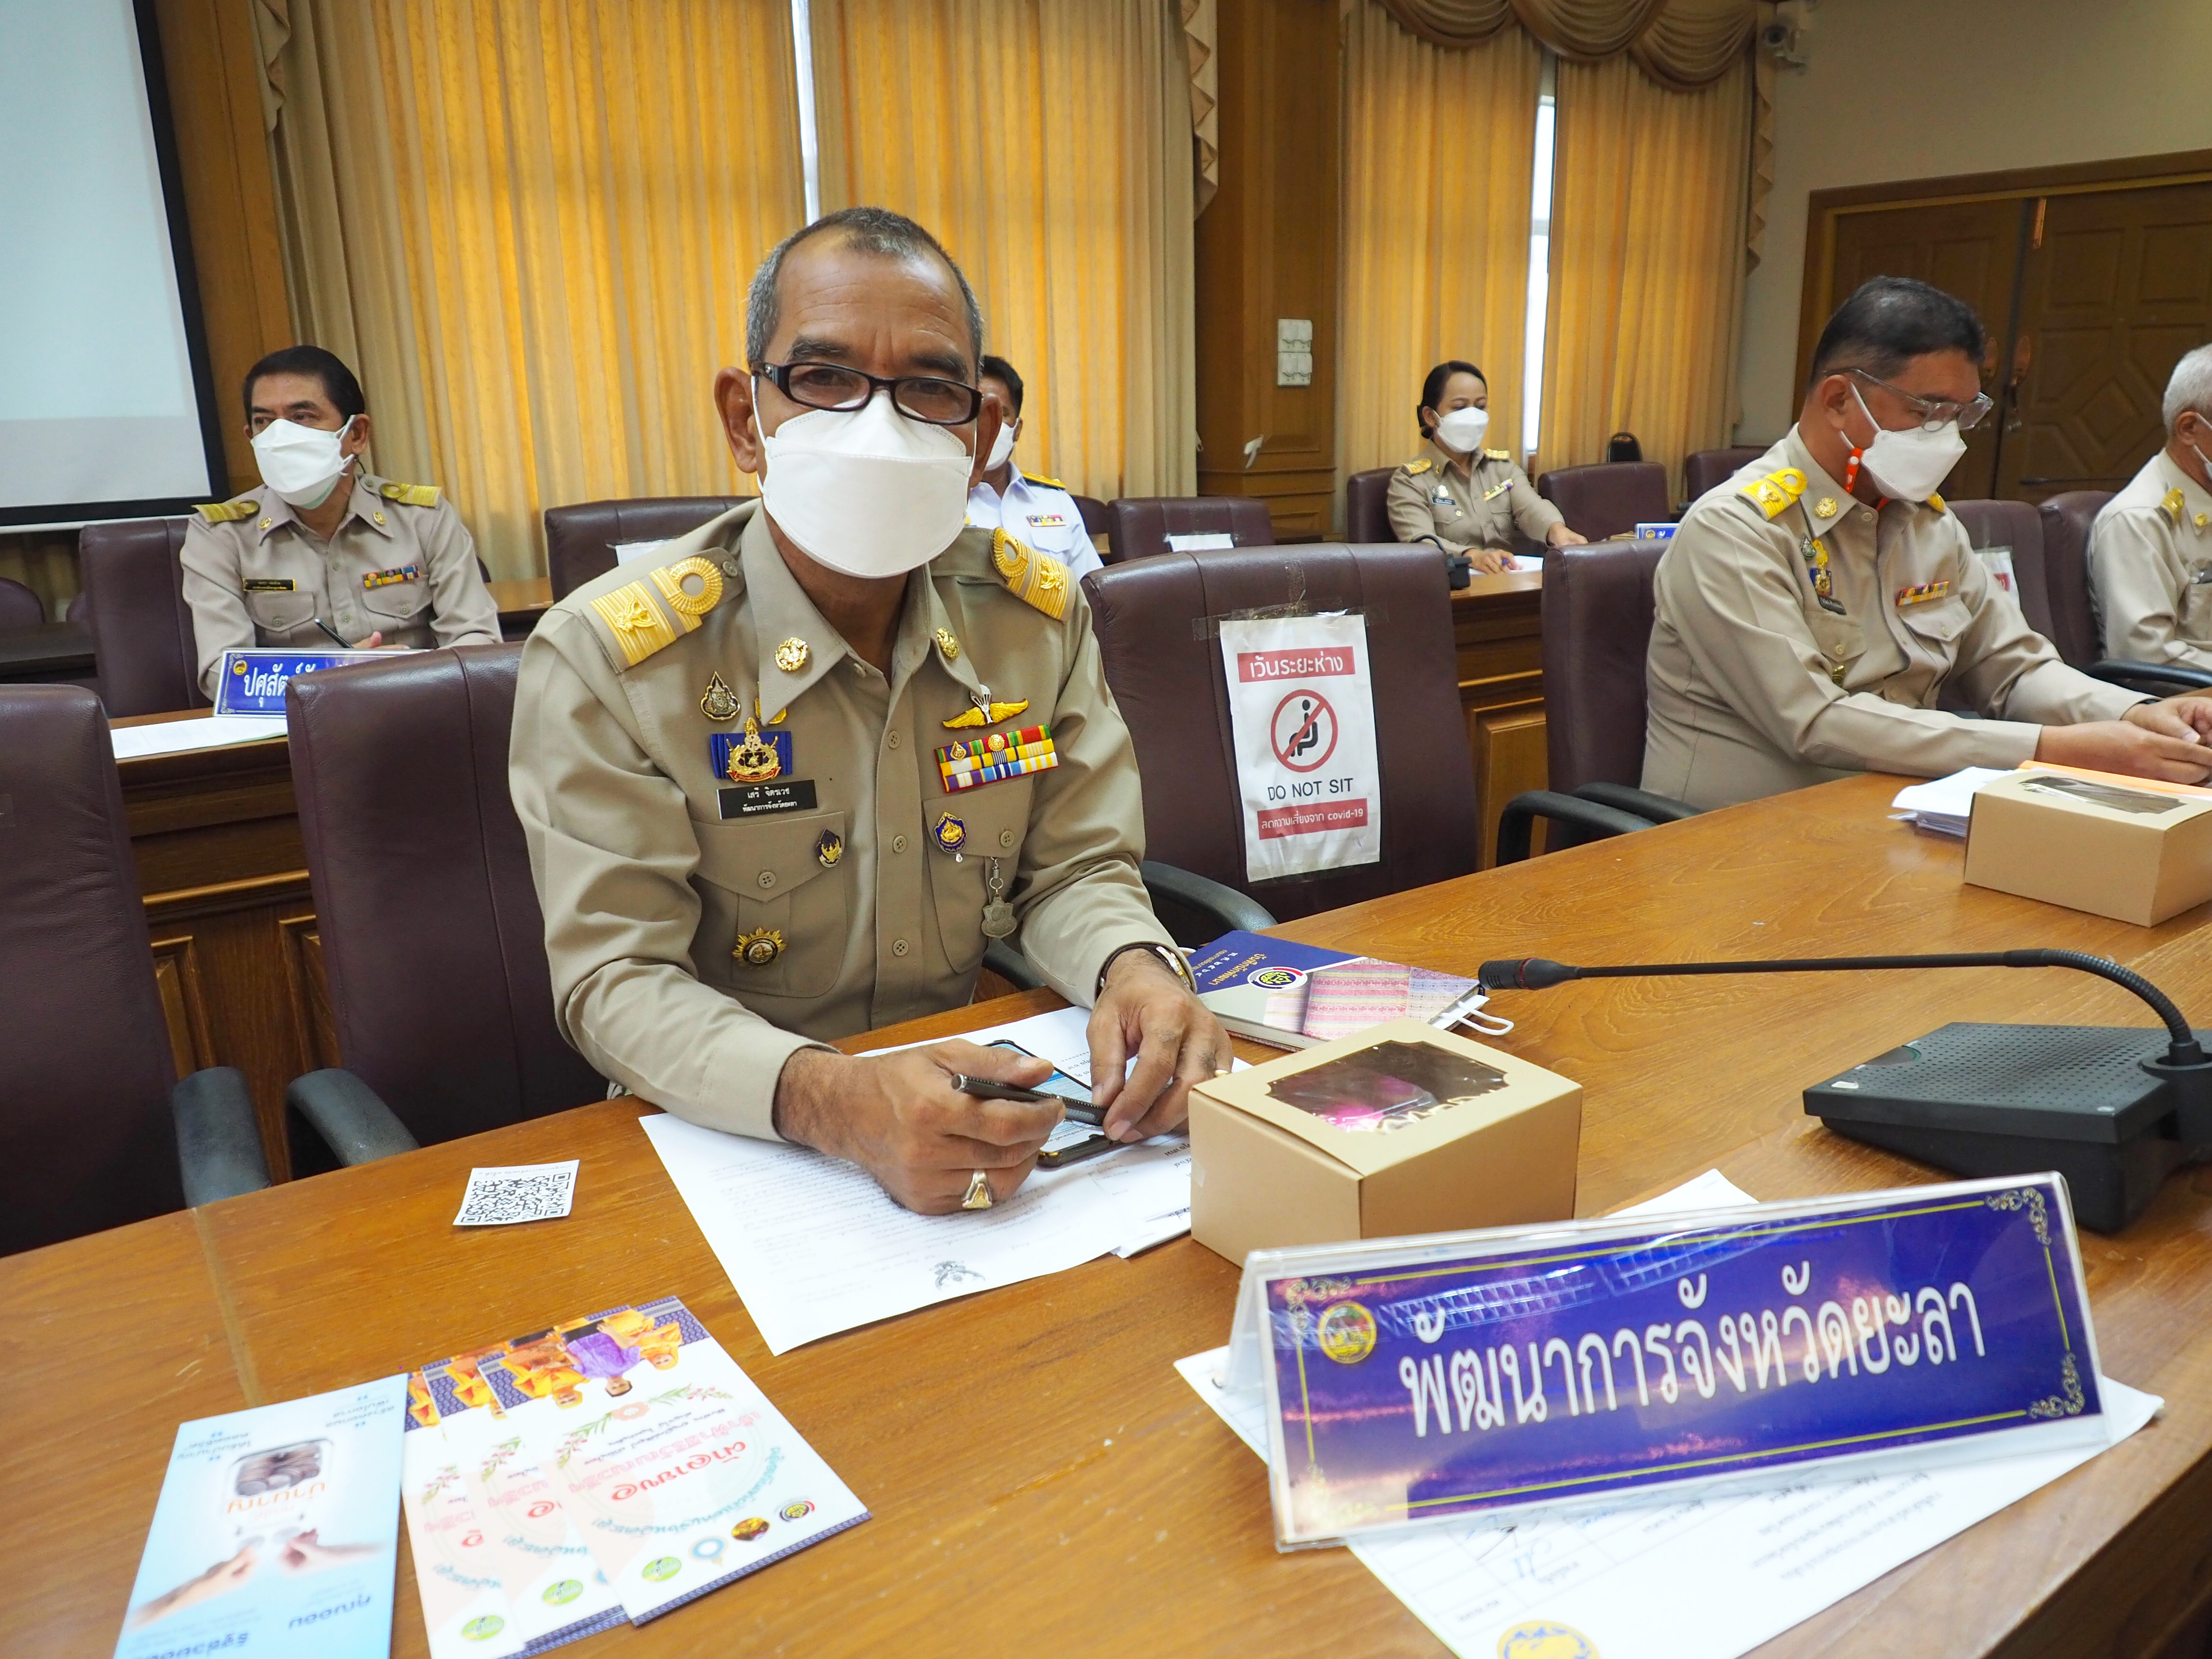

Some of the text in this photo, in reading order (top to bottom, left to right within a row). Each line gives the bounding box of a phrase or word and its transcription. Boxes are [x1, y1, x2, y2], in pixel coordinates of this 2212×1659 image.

[1250, 651, 1343, 677] เว้นระยะห่าง
[1268, 778, 1353, 801] DO NOT SIT
[1262, 808, 1363, 829] ลดความเสี่ยงจาก covid-19
[1398, 1260, 1987, 1438] พัฒนาการจังหวัดยะลา
[612, 1441, 746, 1501] ผ้าลายขอ
